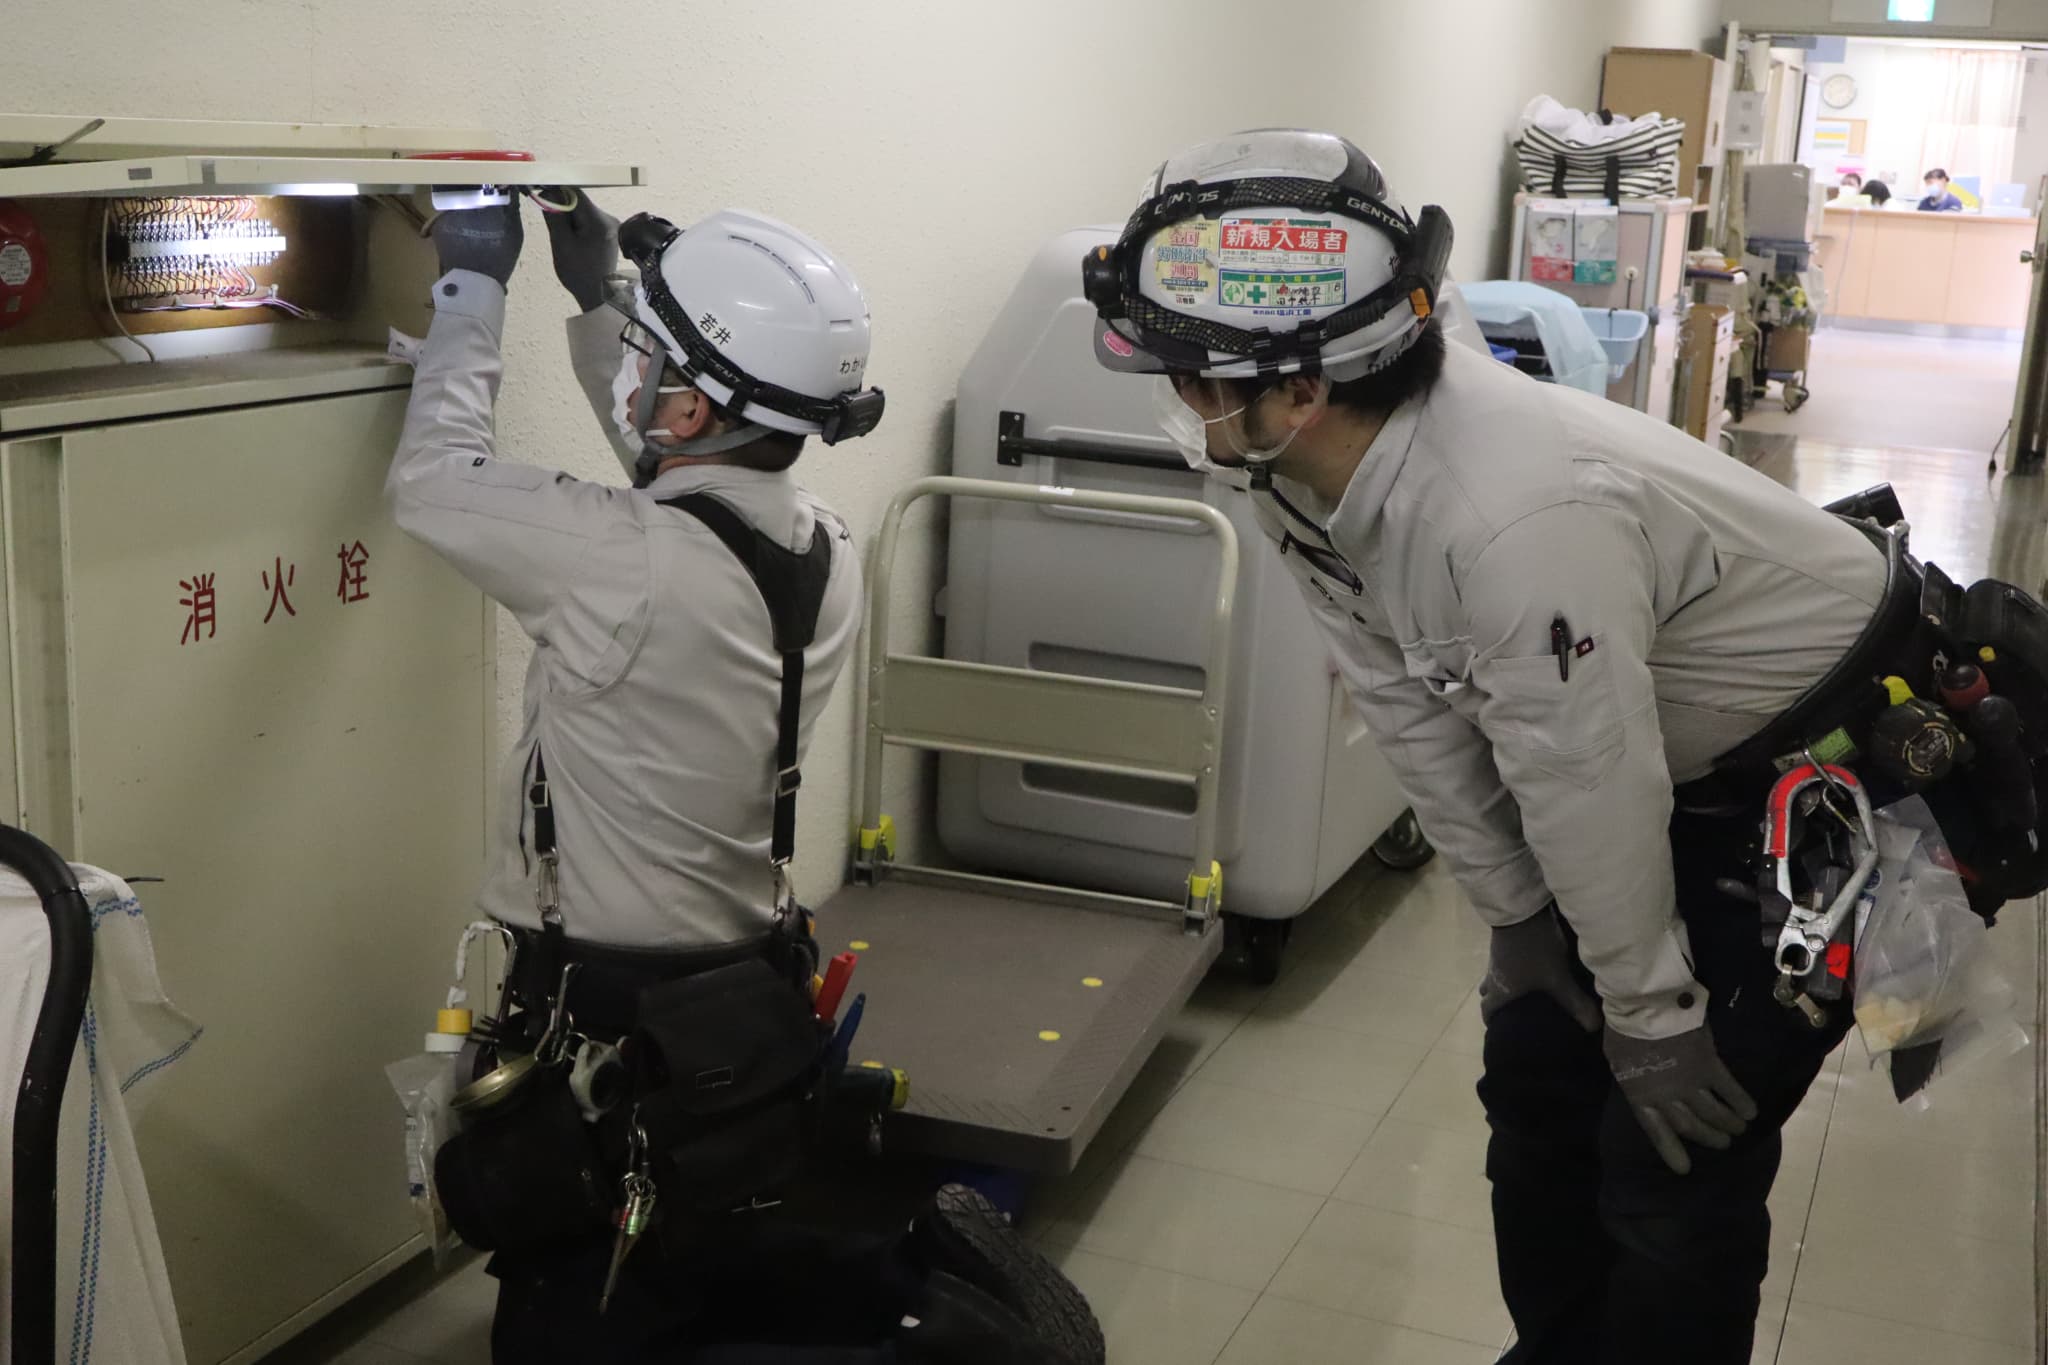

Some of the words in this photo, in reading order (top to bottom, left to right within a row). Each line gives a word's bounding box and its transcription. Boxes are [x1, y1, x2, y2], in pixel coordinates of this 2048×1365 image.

[1226, 227, 1343, 250] 新規入場者
[700, 312, 732, 346] 若井
[179, 540, 370, 645] 消火栓
